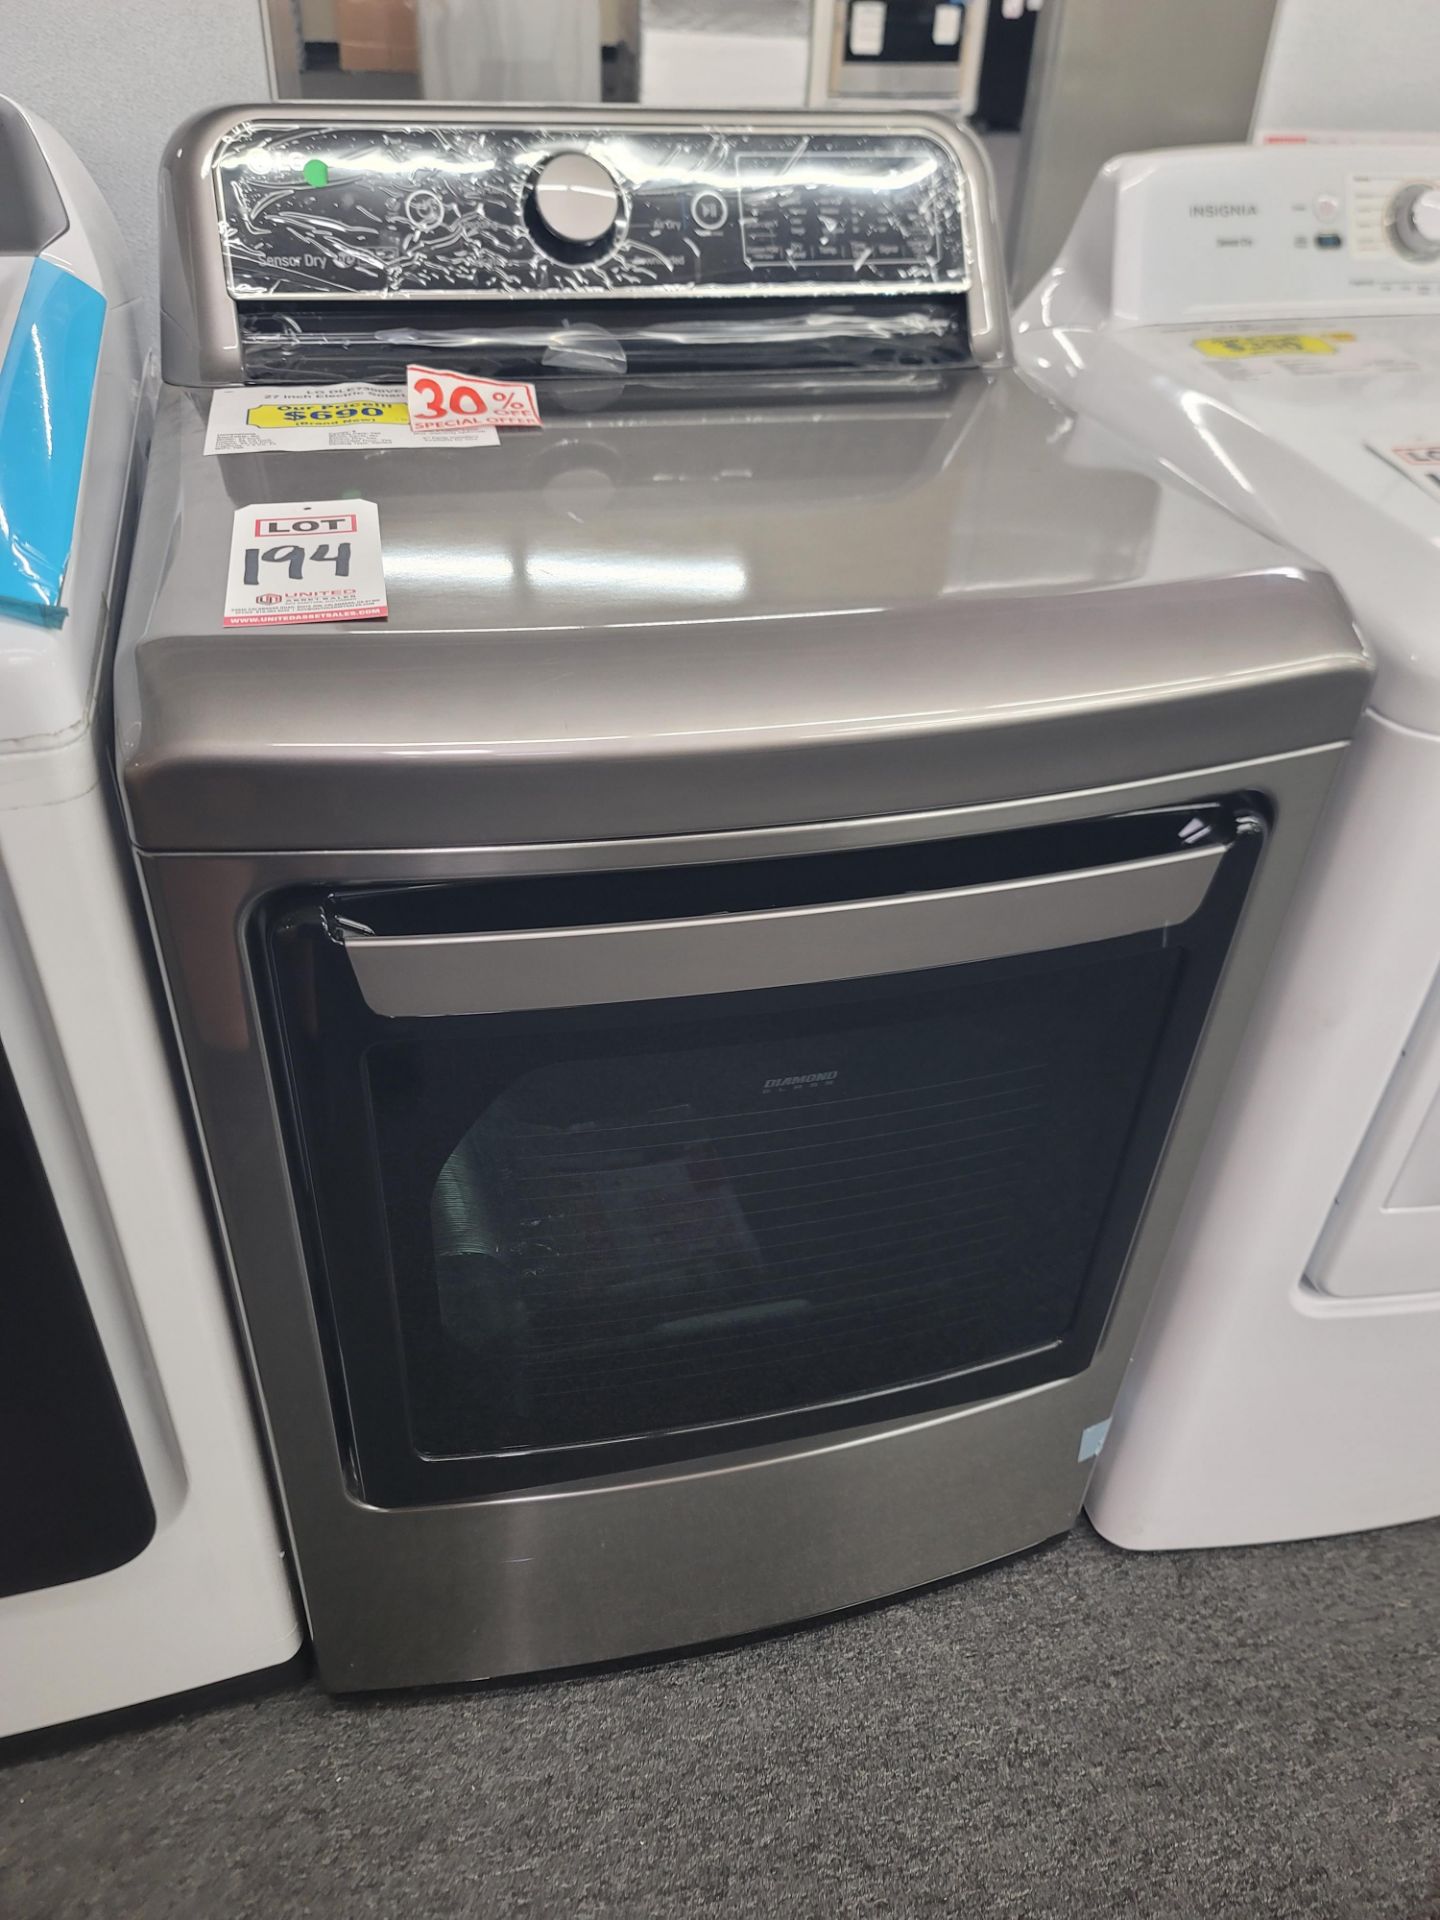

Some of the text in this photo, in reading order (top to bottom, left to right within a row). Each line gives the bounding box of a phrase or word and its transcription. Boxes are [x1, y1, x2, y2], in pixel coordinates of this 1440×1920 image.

[1189, 204, 1258, 218] INSIGNIA
[257, 253, 328, 269] Sensor Dry
[316, 391, 364, 399] Electric
[283, 407, 384, 421] $690
[493, 409, 533, 417] OFF
[415, 417, 538, 429] SPECIAL OFFER
[269, 518, 346, 533] LOT
[244, 542, 351, 585] 194
[285, 589, 357, 598] UNITED
[230, 608, 381, 624] WWW.UNITEDASSETSALES.COM
[764, 1071, 839, 1088] DIAMOND
